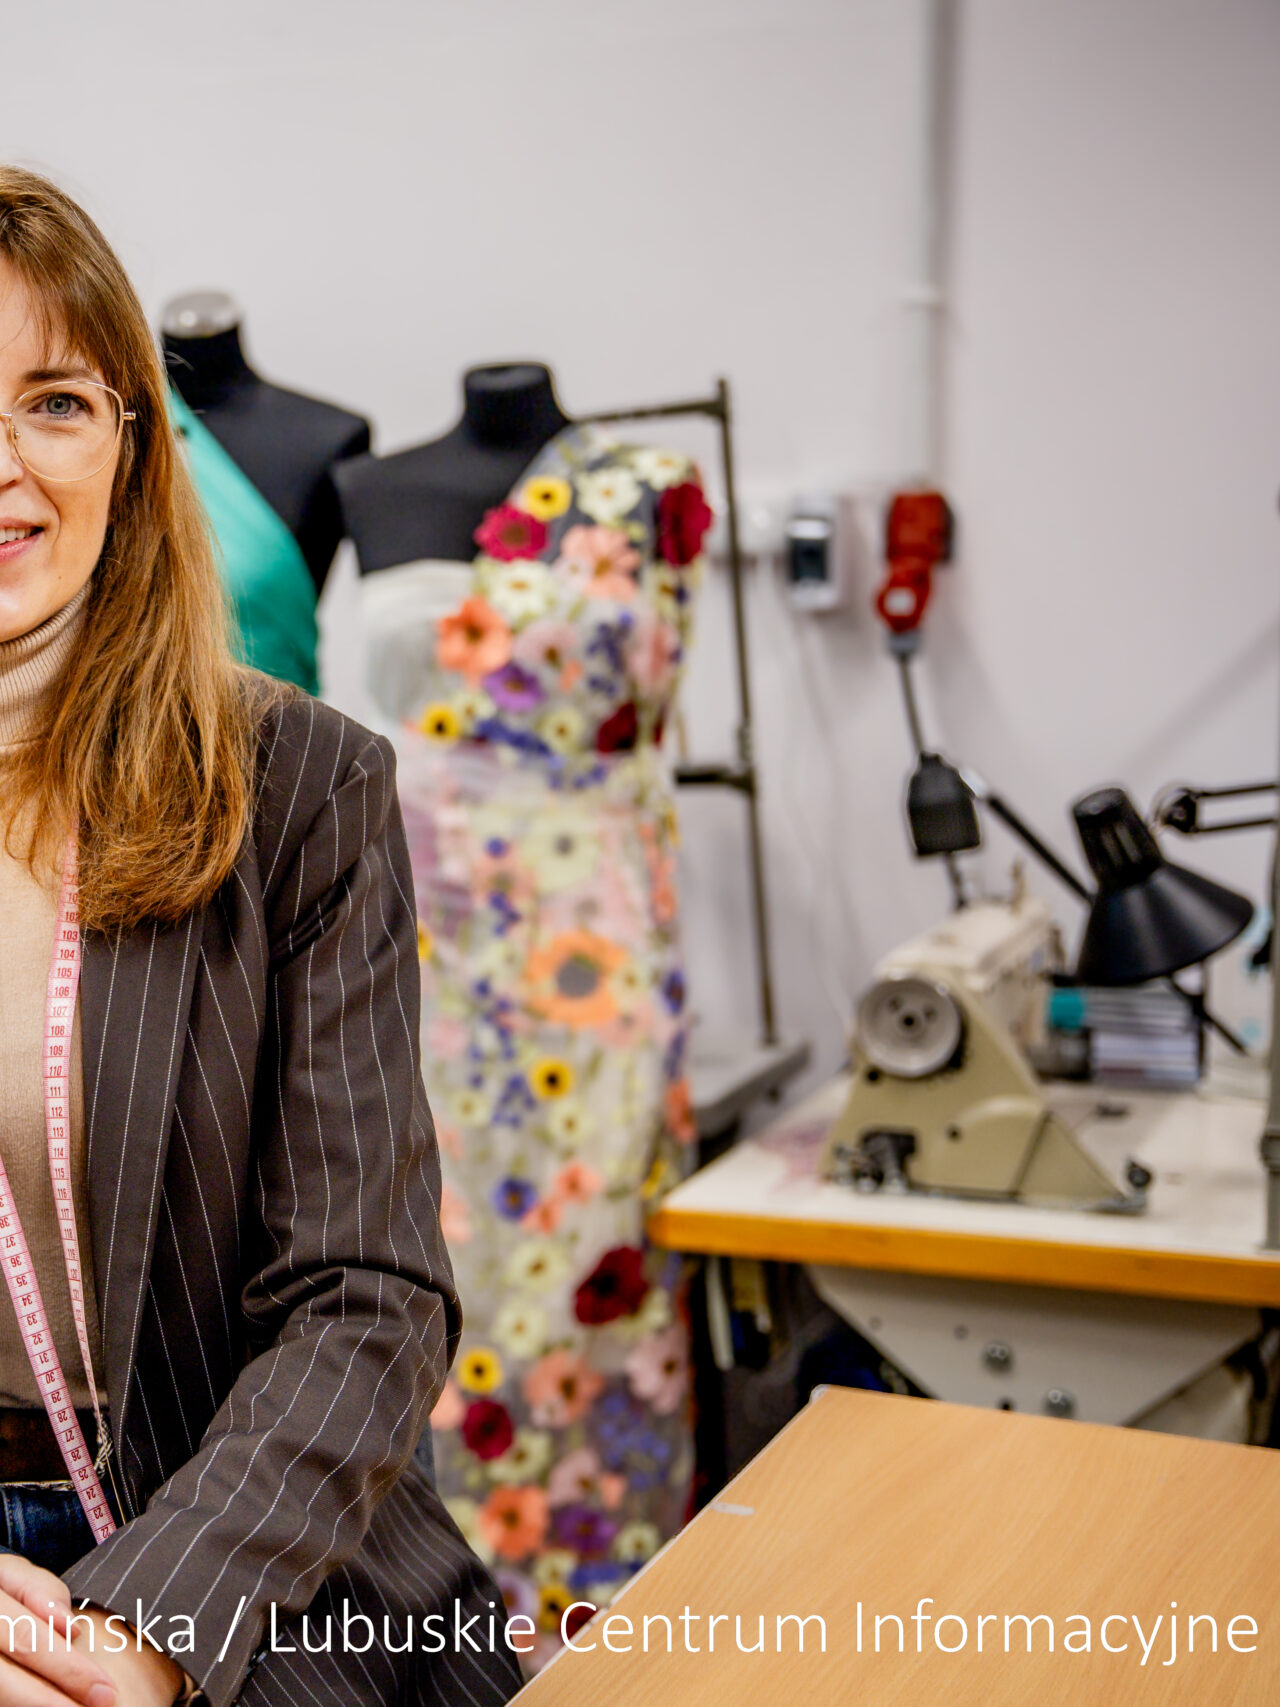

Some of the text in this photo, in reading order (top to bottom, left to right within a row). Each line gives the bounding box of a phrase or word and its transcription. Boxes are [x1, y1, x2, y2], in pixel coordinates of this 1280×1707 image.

[62, 930, 78, 940] 103
[60, 949, 75, 959] 104
[57, 967, 72, 977] 105
[54, 986, 70, 996] 106
[52, 1006, 67, 1016] 107
[50, 1025, 65, 1036] 108
[49, 1046, 64, 1056] 109
[49, 1066, 62, 1076] 110
[50, 1086, 61, 1096] 111
[51, 1107, 63, 1117] 112
[52, 1127, 64, 1137] 113
[53, 1147, 64, 1157] 114
[54, 1167, 65, 1178] 115
[0, 1217, 10, 1228] 38
[5, 1237, 16, 1248] 37
[11, 1256, 22, 1267] 36
[16, 1276, 28, 1287] 35
[22, 1296, 33, 1306] 34
[27, 1315, 38, 1326] 33
[33, 1334, 43, 1345] 32
[39, 1353, 50, 1364] 31
[45, 1373, 56, 1384] 30
[51, 1392, 62, 1403] 29
[57, 1412, 68, 1422] 28
[65, 1431, 75, 1442] 27
[71, 1451, 82, 1462] 26
[78, 1470, 89, 1481] 25
[86, 1489, 96, 1500] 24
[93, 1508, 104, 1520] 23
[100, 1527, 110, 1538] 22
